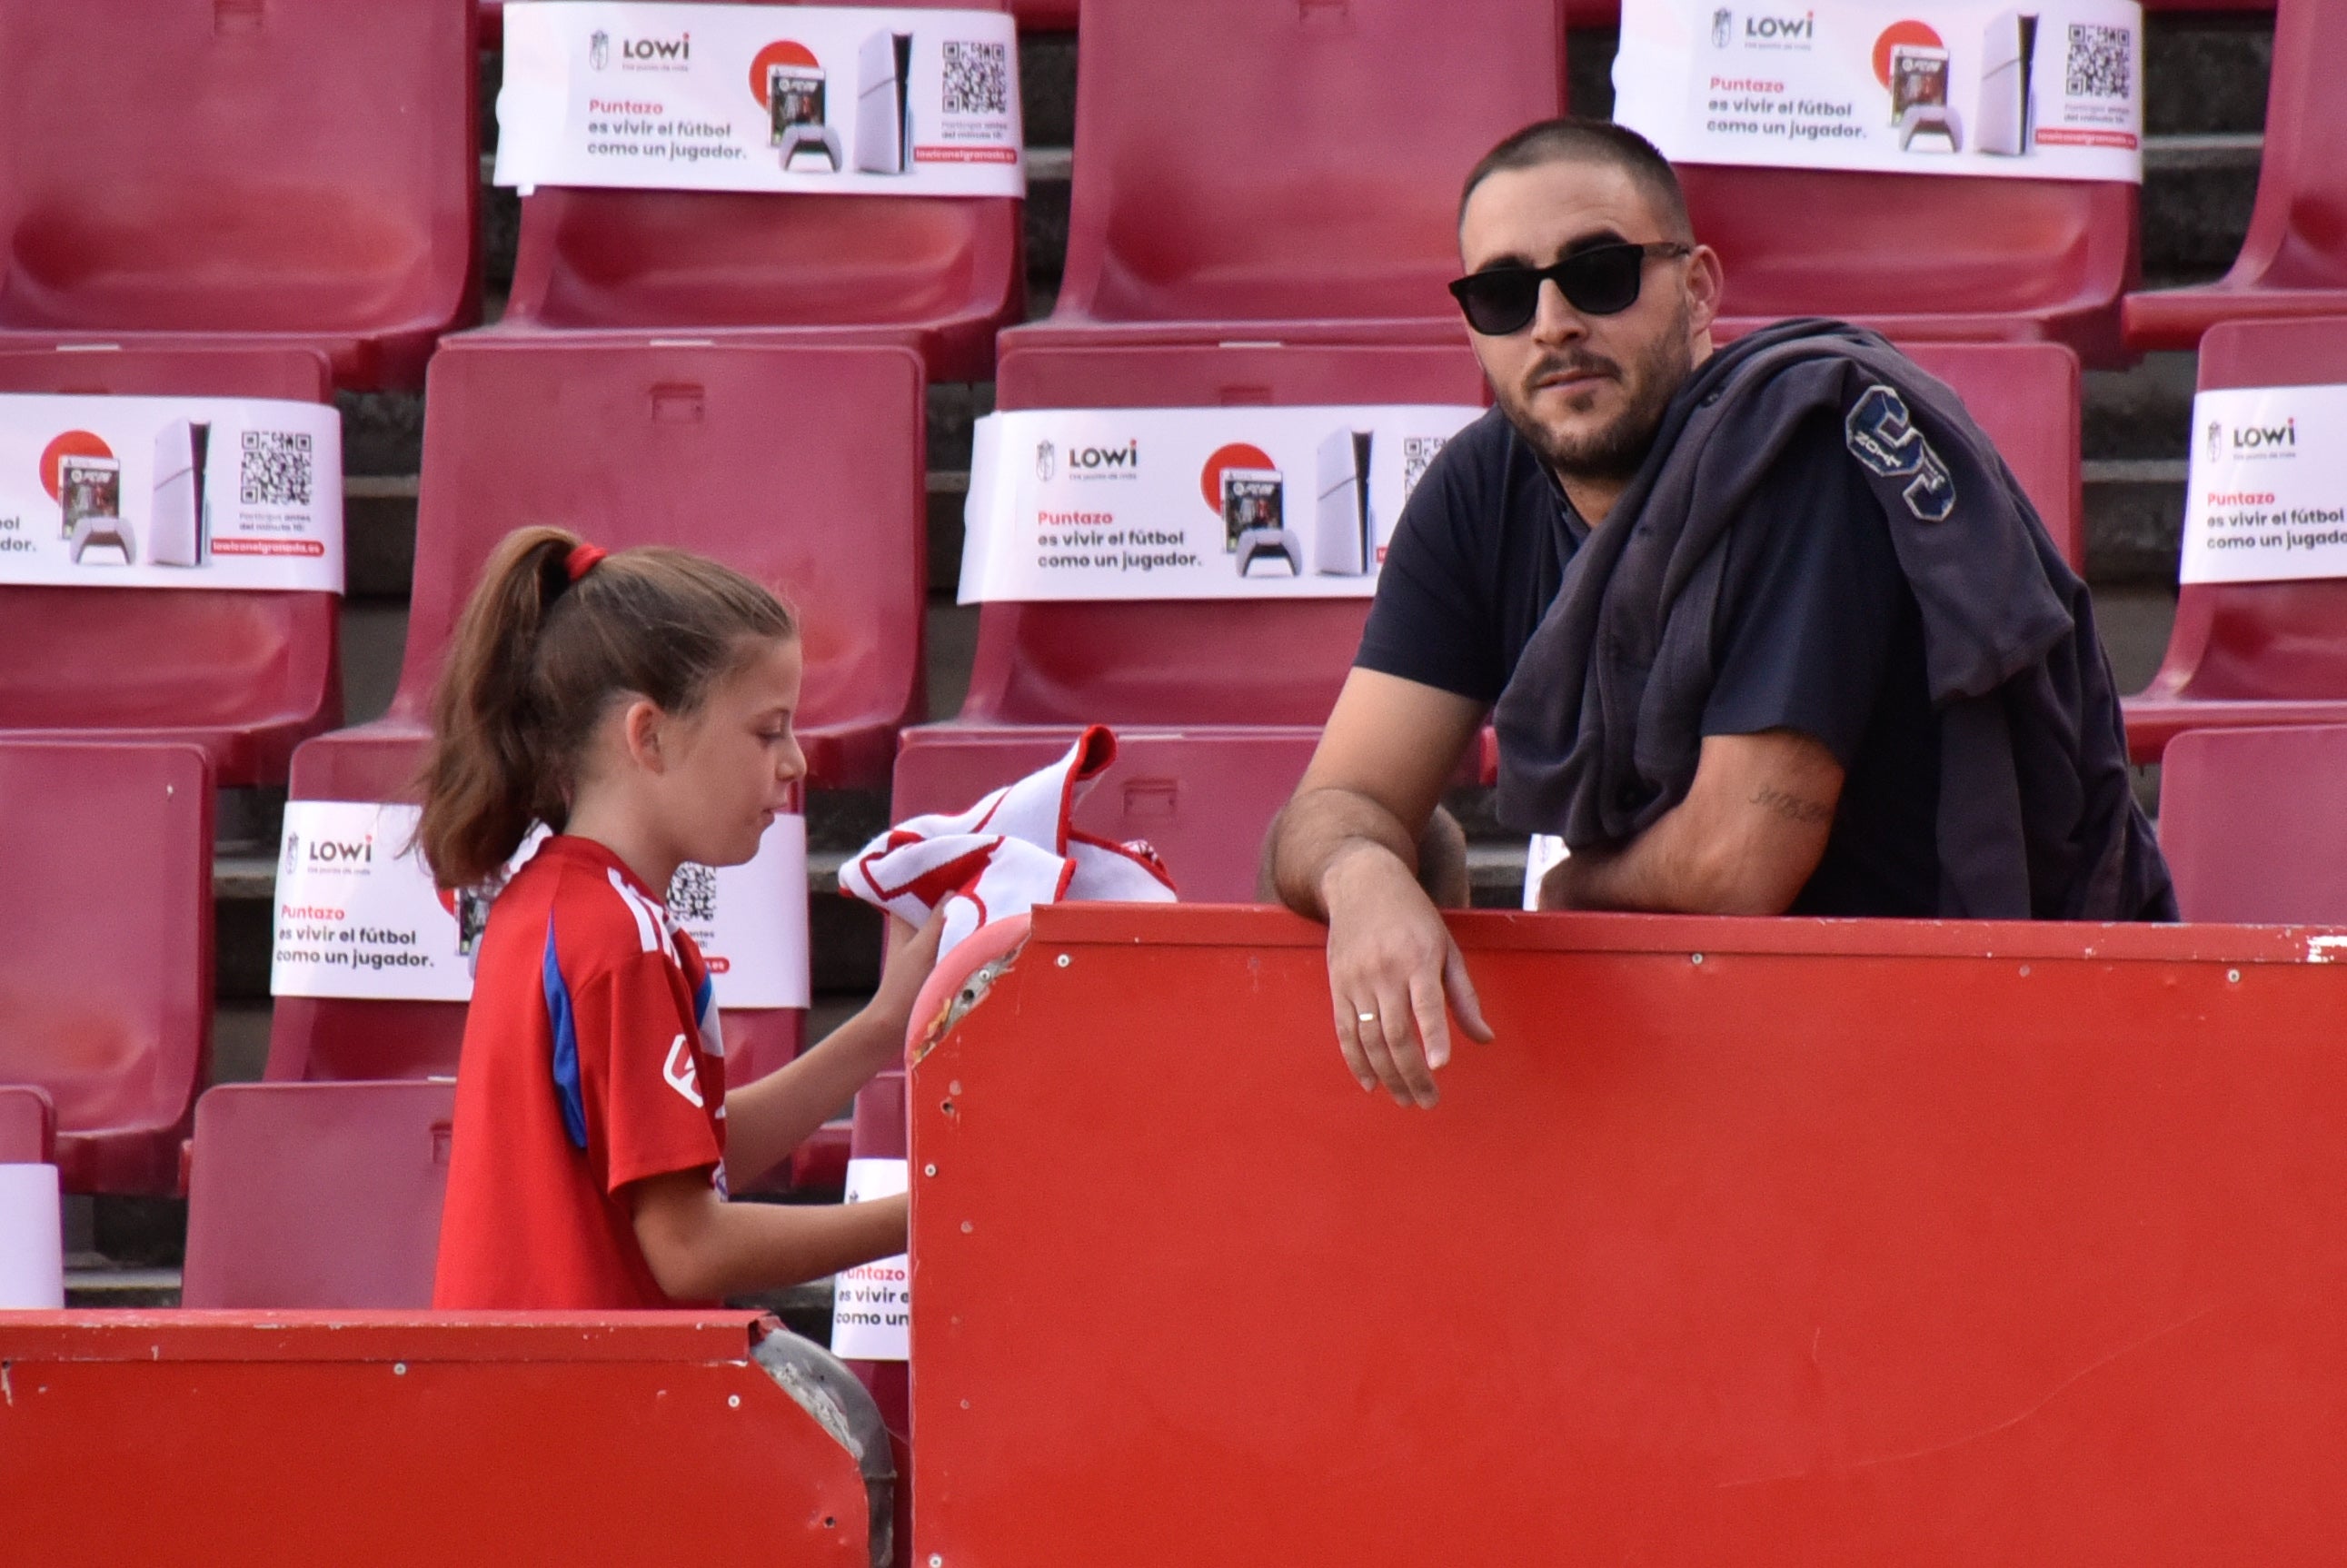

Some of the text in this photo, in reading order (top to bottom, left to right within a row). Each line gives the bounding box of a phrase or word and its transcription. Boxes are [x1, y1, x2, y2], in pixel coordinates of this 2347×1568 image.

[1709, 77, 1785, 94] Puntazo
[588, 100, 664, 116] Puntazo
[1708, 99, 1852, 118] es vivir el fútbol
[588, 120, 732, 138] es vivir el fútbol
[1706, 118, 1867, 141] como un jugador.
[587, 141, 747, 162] como un jugador.
[2207, 492, 2275, 506] Puntazo
[0, 516, 20, 530] ol
[1038, 511, 1113, 527] Puntazo
[2207, 508, 2345, 527] es vivir el fútbol
[1038, 530, 1185, 547] es vivir el fútbol
[2207, 535, 2255, 549] como
[2260, 534, 2282, 547] un
[1038, 549, 1202, 571] como un jugador.
[281, 905, 345, 921] Puntazo
[279, 925, 417, 945] es vivir el fútbol
[276, 947, 435, 970] como un jugador.
[839, 1291, 851, 1303] es
[856, 1286, 896, 1304] vivir
[836, 1313, 881, 1326] como
